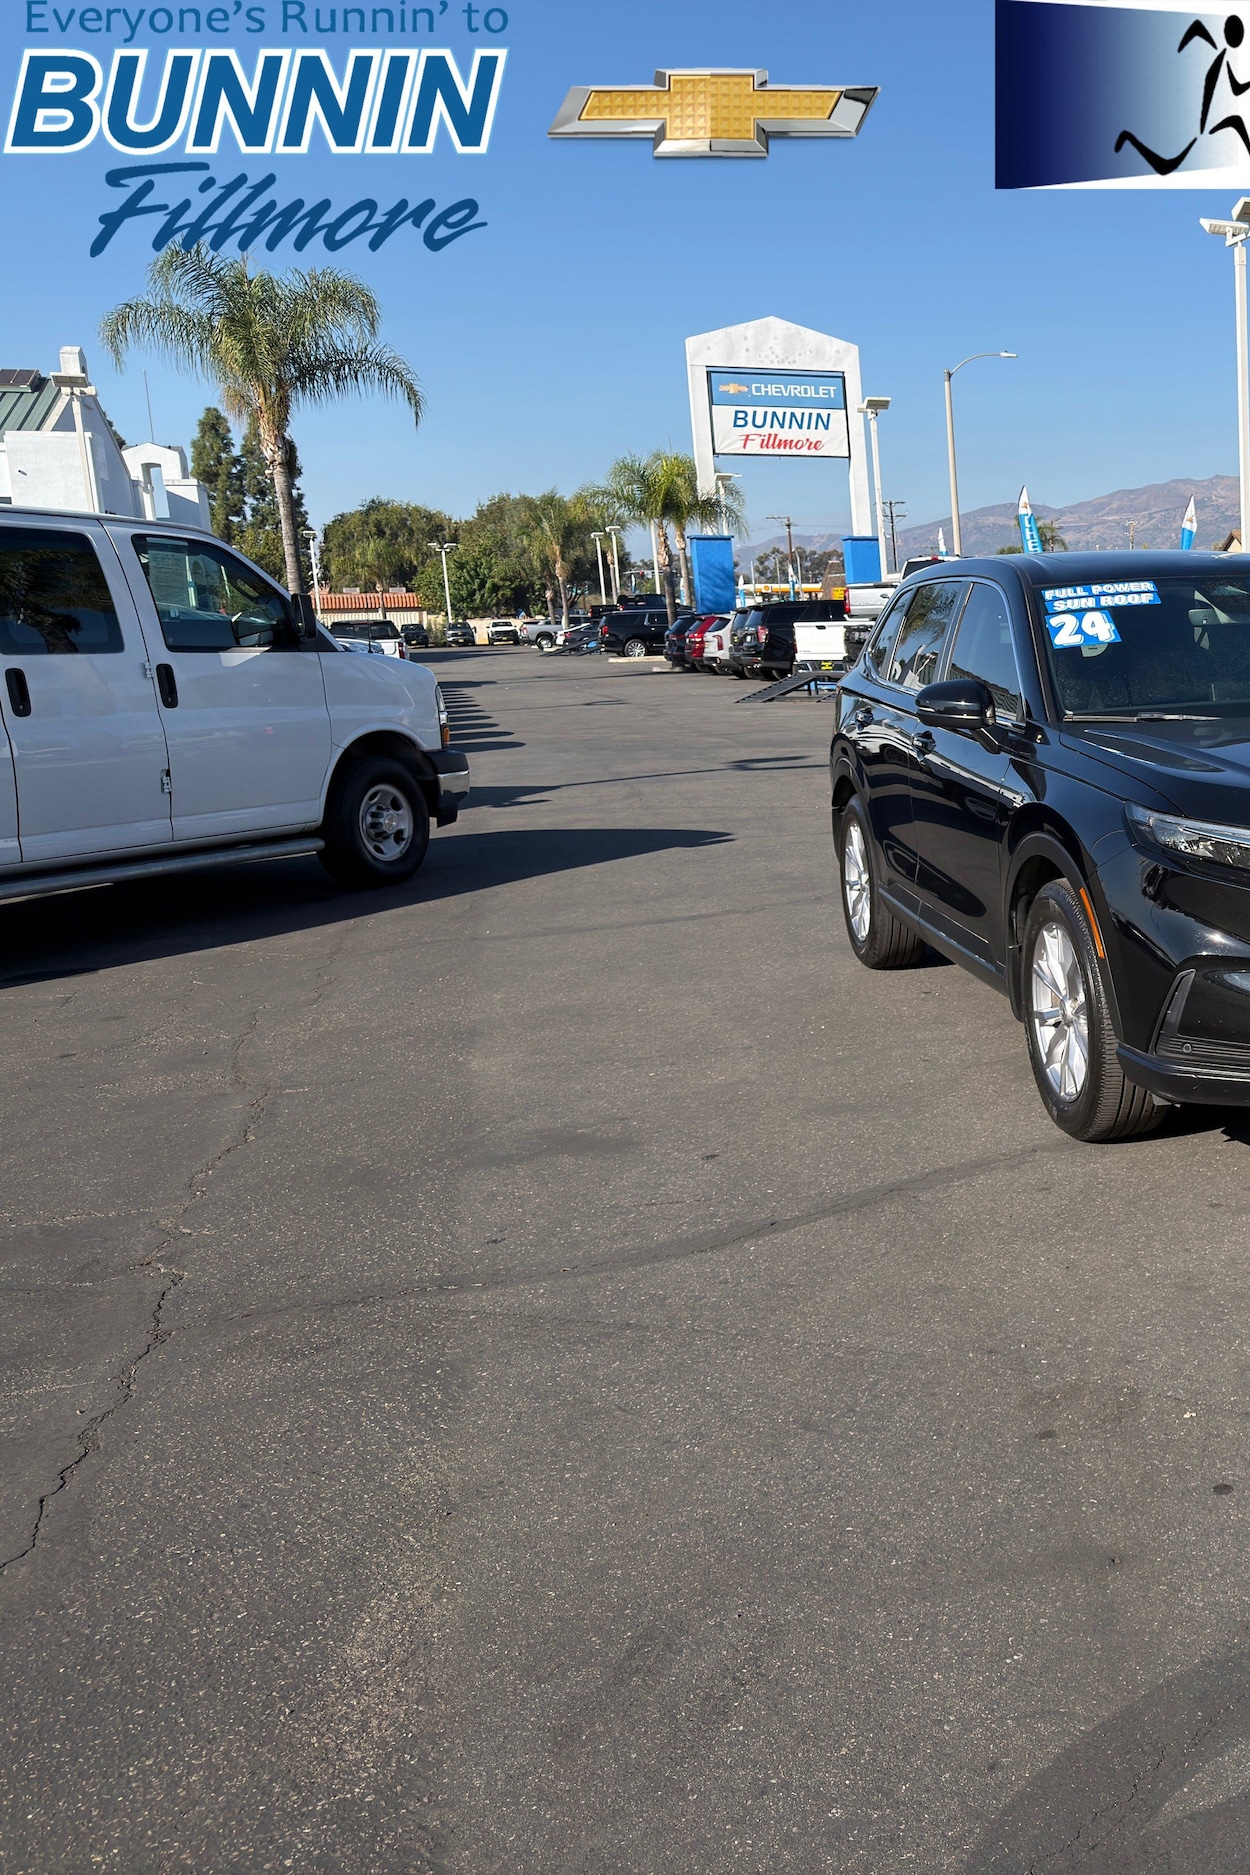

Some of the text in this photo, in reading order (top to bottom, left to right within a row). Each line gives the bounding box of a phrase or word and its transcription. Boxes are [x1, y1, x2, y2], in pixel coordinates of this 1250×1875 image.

[751, 383, 837, 398] CHEVROLET
[732, 409, 831, 431] BUNNIN
[738, 433, 824, 451] Fillmore
[1045, 581, 1155, 600] FULL POWER
[1053, 593, 1154, 611] SUN ROOF
[1049, 611, 1115, 646] 24
